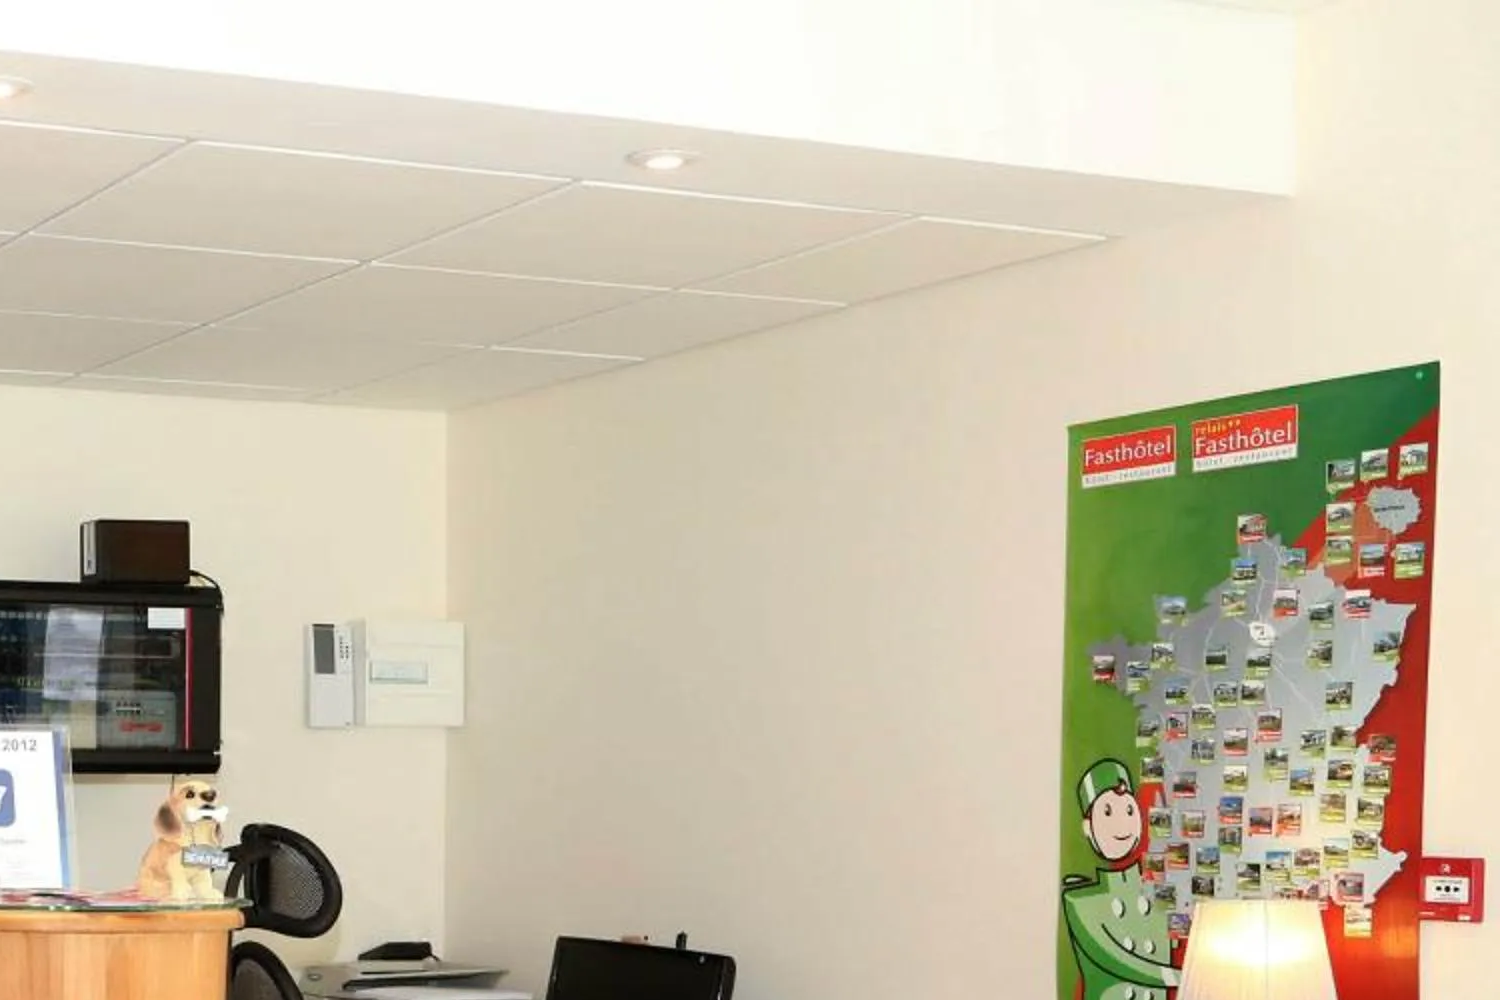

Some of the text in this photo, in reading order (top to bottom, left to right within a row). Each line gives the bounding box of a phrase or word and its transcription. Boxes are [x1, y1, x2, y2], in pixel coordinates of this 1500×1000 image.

[1085, 434, 1171, 467] Fasthôtel
[1195, 420, 1293, 456] Fasthôtel
[1, 738, 37, 752] 2012
